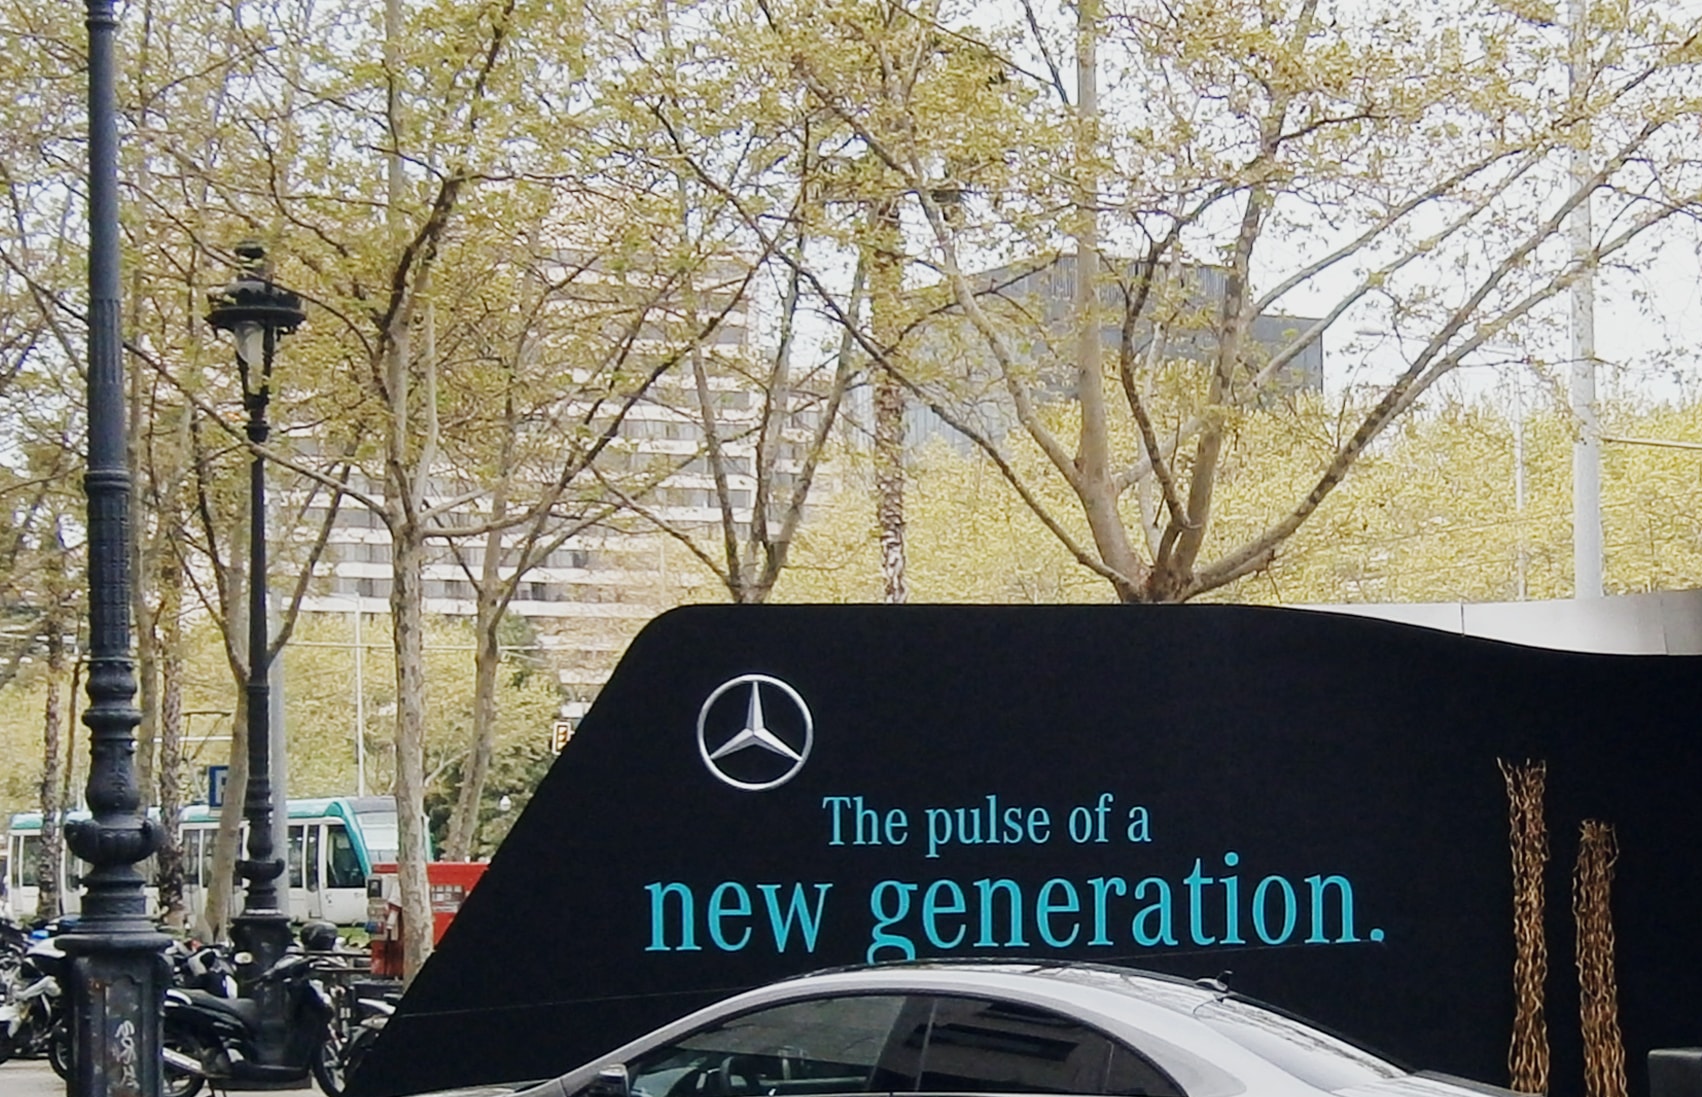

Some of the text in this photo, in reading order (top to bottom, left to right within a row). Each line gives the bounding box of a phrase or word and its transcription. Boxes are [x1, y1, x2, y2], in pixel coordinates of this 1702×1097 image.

[822, 792, 1152, 858] The pulse of a
[644, 851, 1386, 966] new generation.
